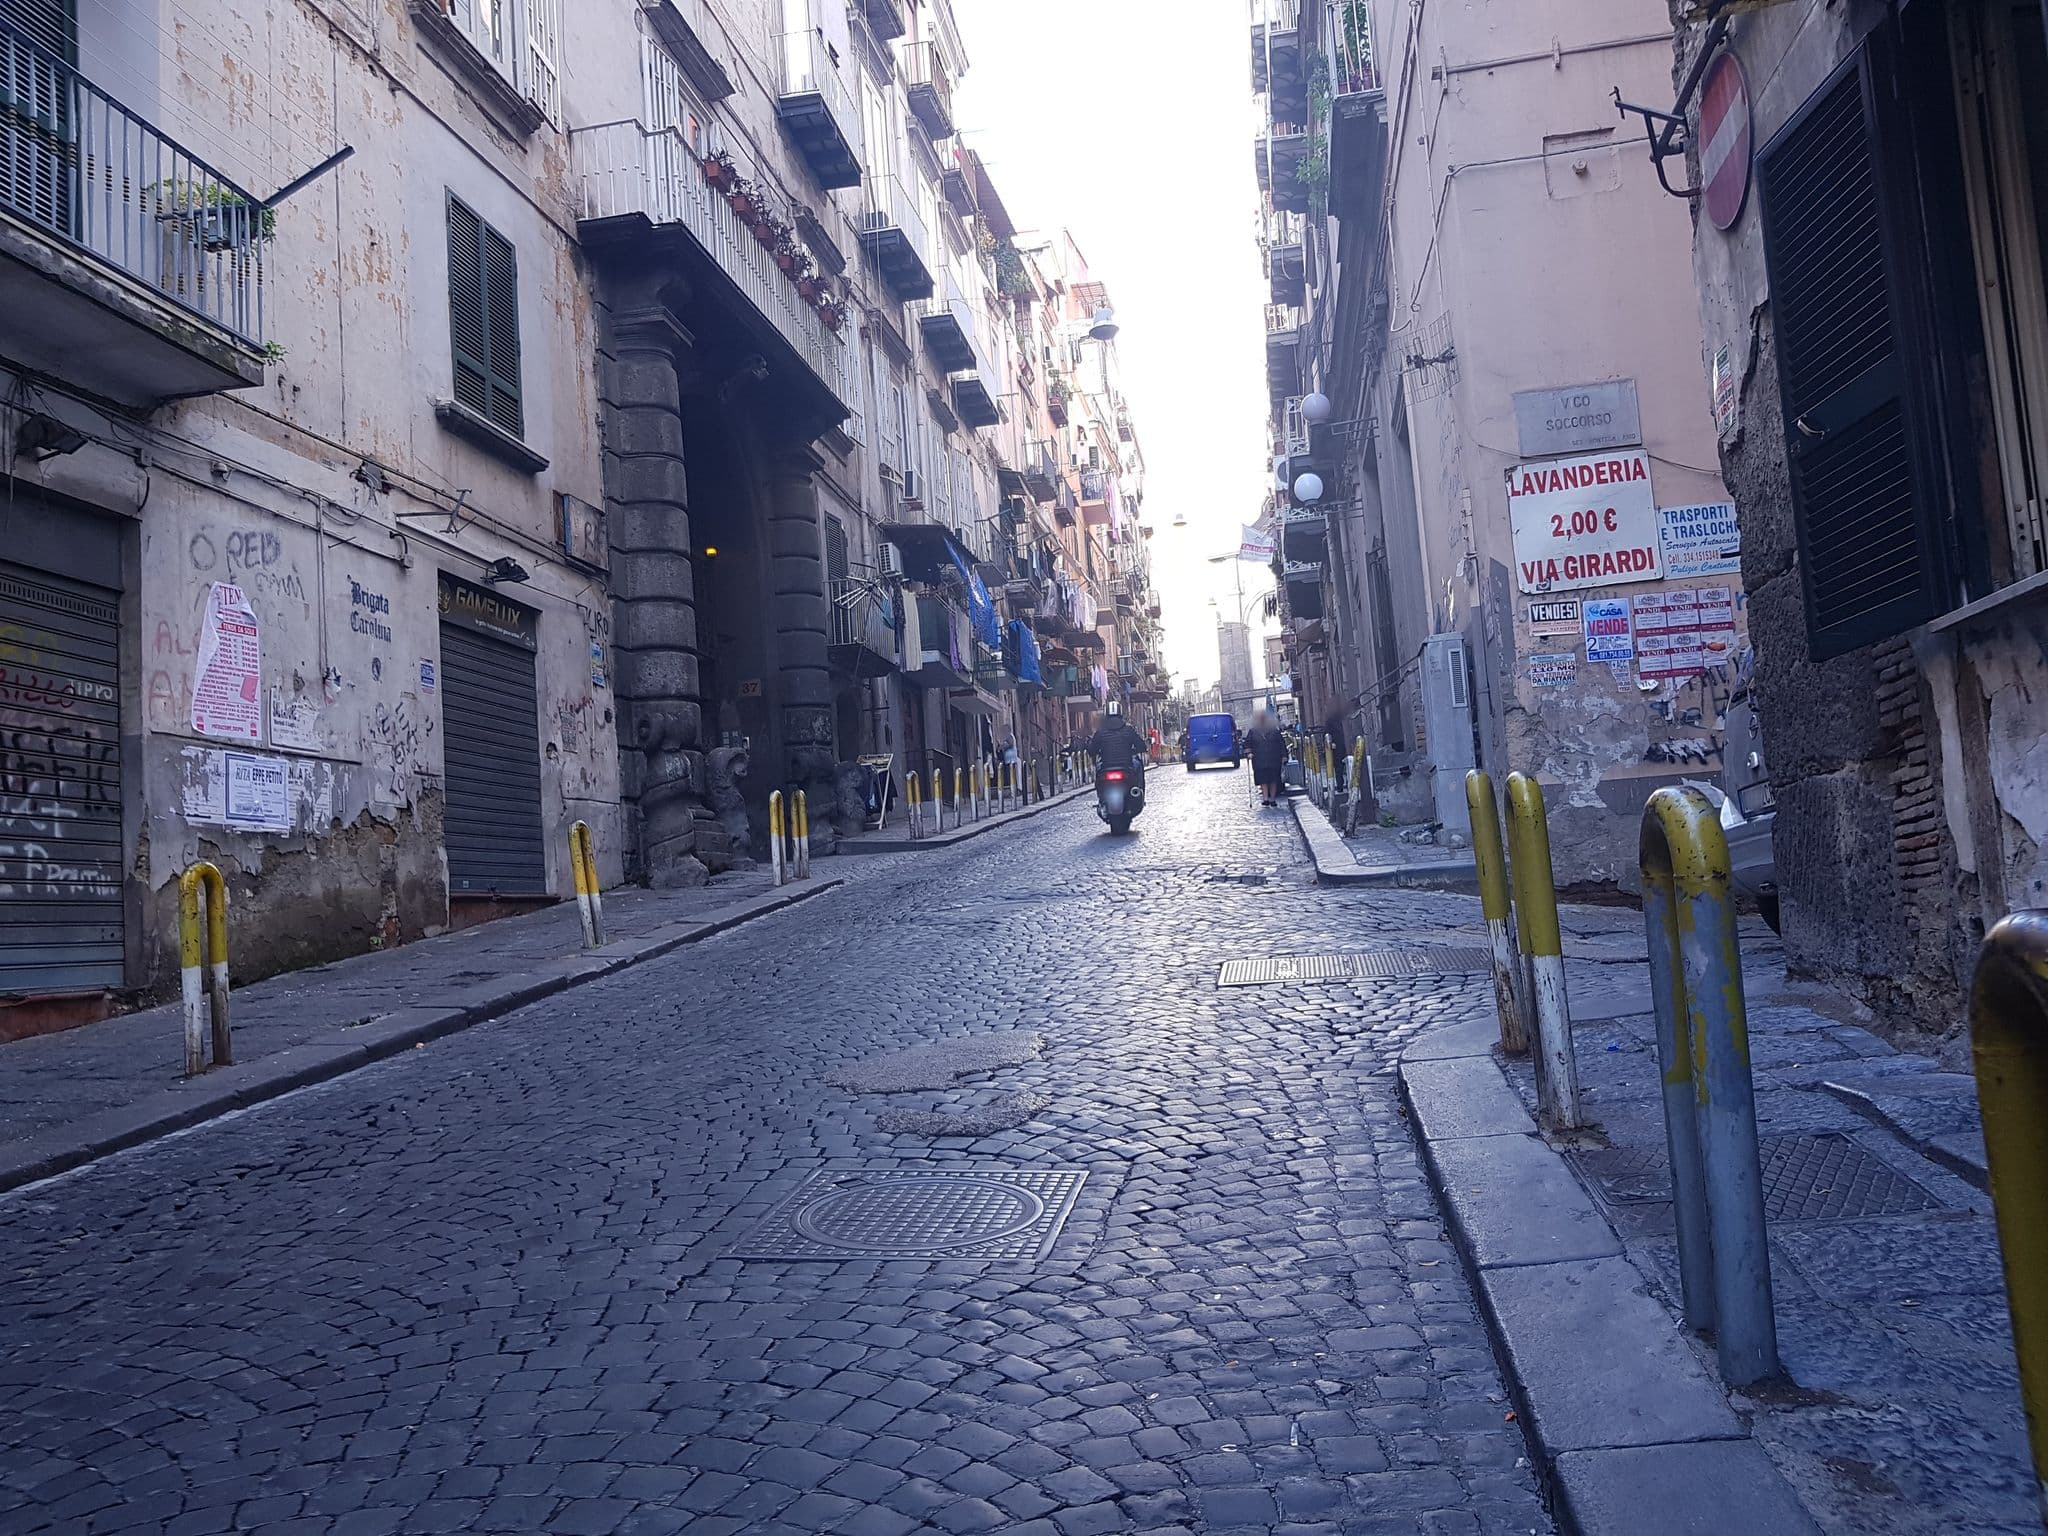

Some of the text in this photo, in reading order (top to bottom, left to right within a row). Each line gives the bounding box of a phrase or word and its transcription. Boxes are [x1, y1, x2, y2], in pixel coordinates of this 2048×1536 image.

[1546, 412, 1611, 431] SOCCORSO
[1511, 458, 1646, 497] LAVANDERIA
[1663, 505, 1728, 524] TRASPORTI
[1551, 508, 1617, 541] 2,00 €
[1661, 528, 1668, 540] E
[1521, 547, 1655, 584] VIA GIRARDI
[350, 581, 389, 615] Brigata
[1532, 603, 1577, 620] VENDESI
[1600, 608, 1623, 617] CASA
[1587, 618, 1630, 636] VENDE
[1587, 637, 1598, 651] 2
